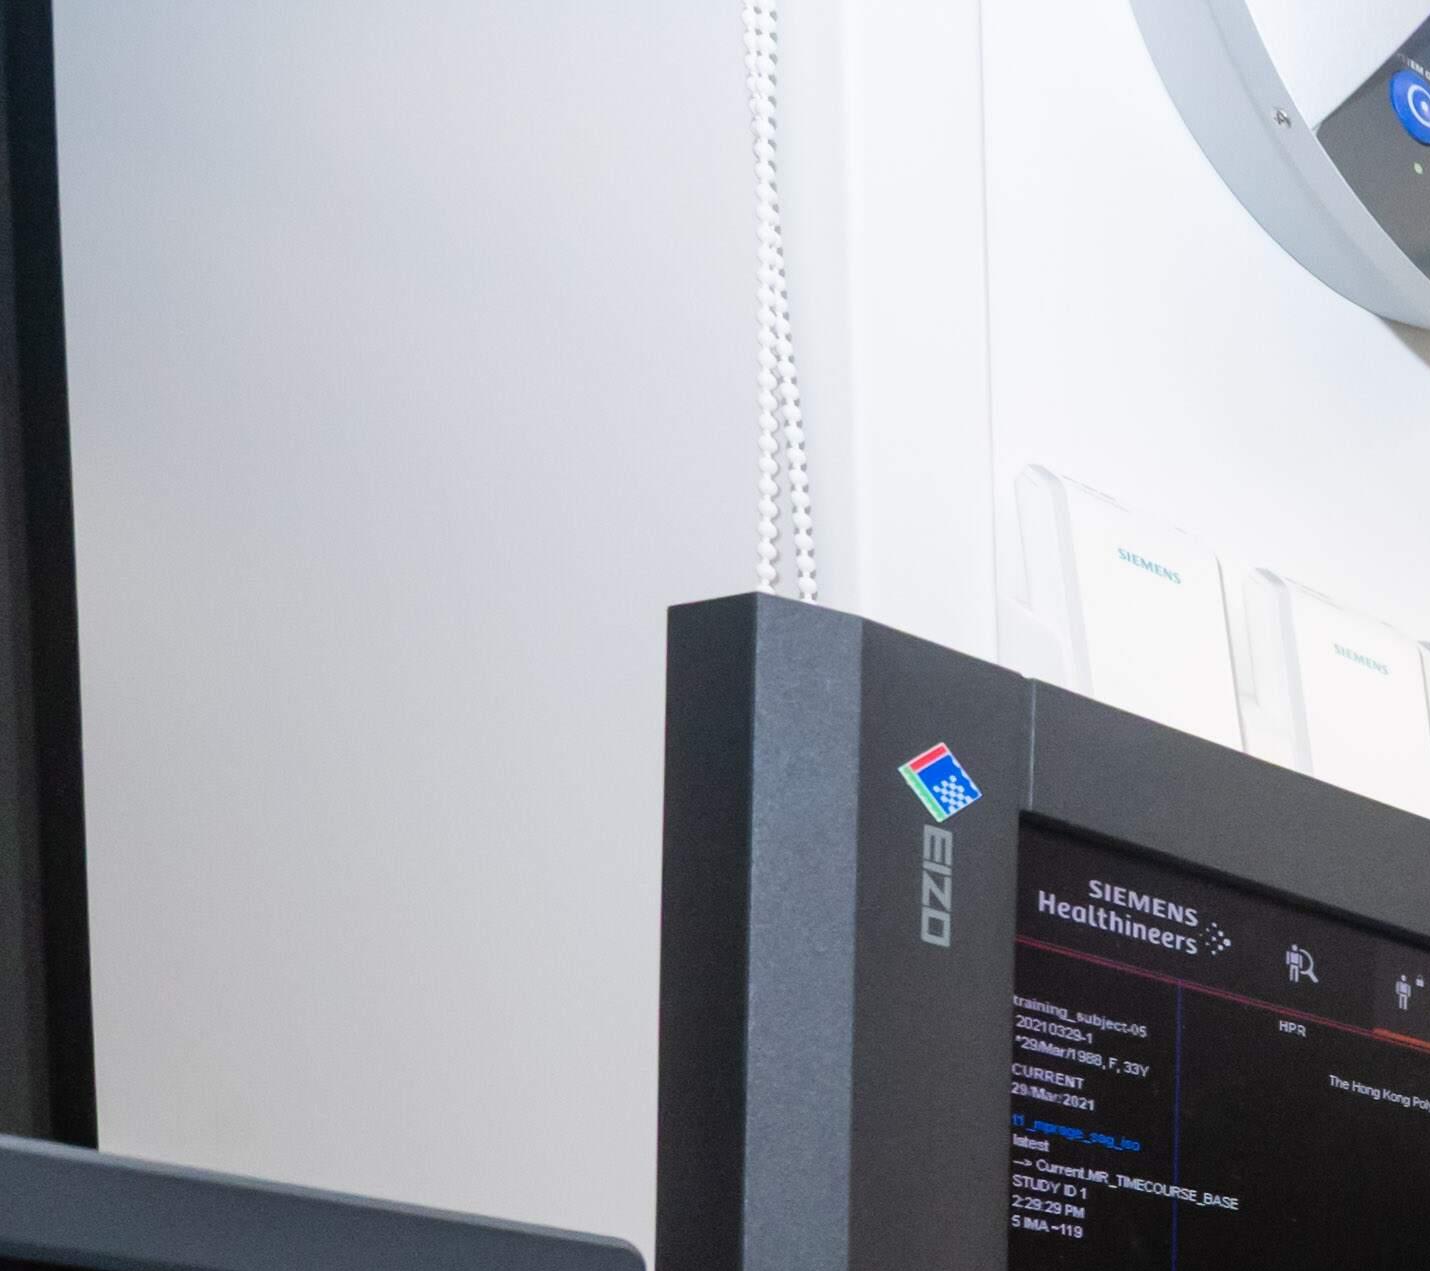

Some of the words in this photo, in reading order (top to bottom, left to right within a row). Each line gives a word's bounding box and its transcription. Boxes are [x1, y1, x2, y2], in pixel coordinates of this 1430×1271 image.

[1118, 548, 1181, 584] SIEMENS
[1334, 643, 1388, 675] SIEMENS
[921, 824, 952, 947] EIZO
[1089, 880, 1199, 927] SIEMENS
[1038, 890, 1198, 955] Healthineers
[1014, 994, 1147, 1039] training_subject-05
[1016, 1016, 1094, 1045] 20210329-1
[1279, 1020, 1306, 1037] HPR
[1011, 1064, 1084, 1090] CURRENT
[1330, 1075, 1349, 1092] The
[1352, 1081, 1380, 1102] Hong
[1382, 1088, 1410, 1108] Kong
[1013, 1134, 1049, 1153] latest
[1013, 1174, 1061, 1197] STUDY
[1064, 1182, 1077, 1199] ID
[1081, 1185, 1087, 1201] 1
[1013, 1195, 1062, 1216] 2:29:29
[1064, 1200, 1085, 1219] PM
